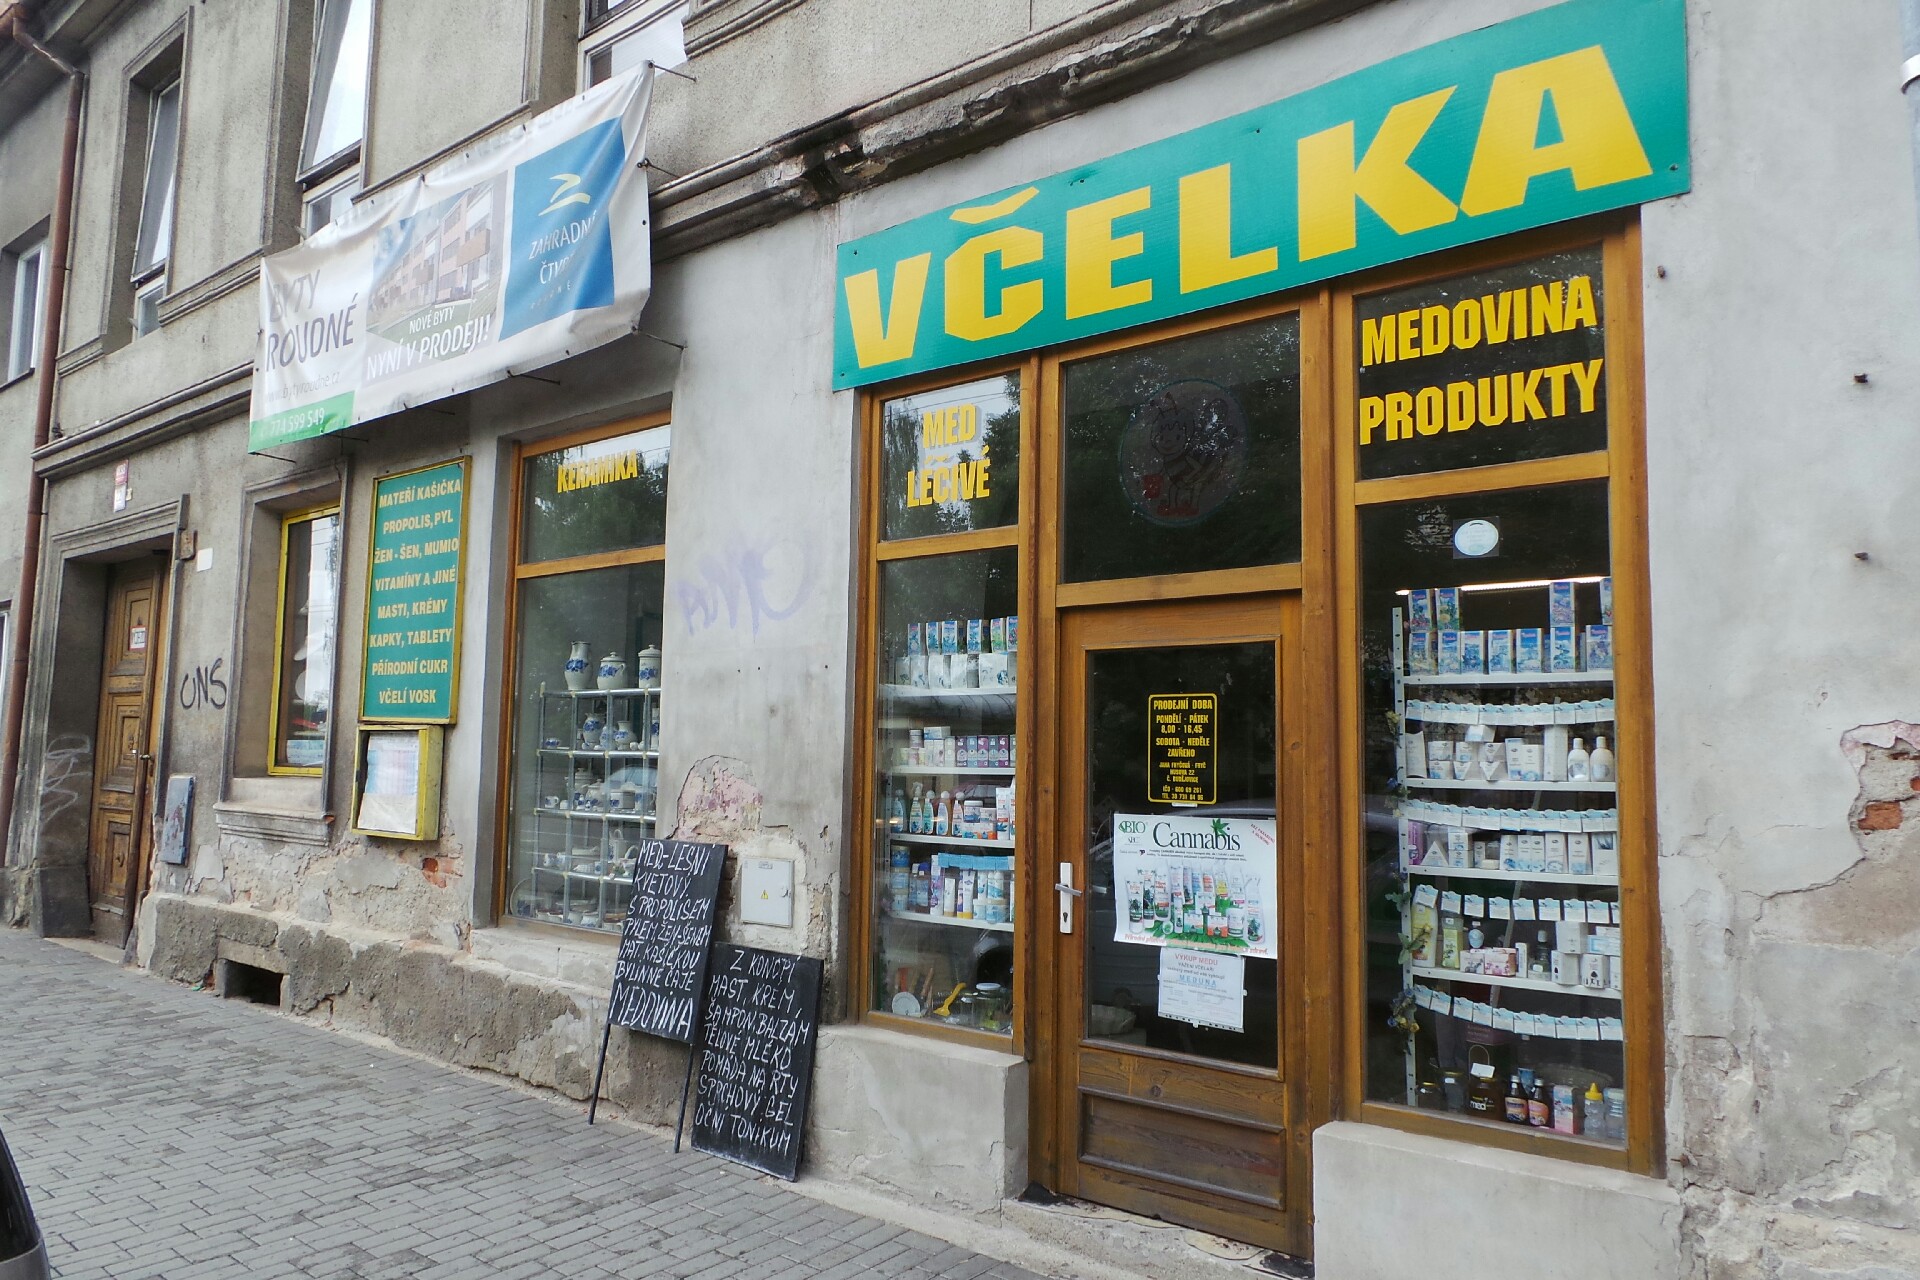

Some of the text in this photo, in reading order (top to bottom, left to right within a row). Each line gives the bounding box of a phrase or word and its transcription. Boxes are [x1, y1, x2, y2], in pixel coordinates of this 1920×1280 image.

[844, 45, 1653, 369] VČELKA
[269, 269, 321, 322] BYTY
[266, 292, 359, 372] ROUDNÉ
[409, 306, 455, 334] NOVÉ BYTY
[1362, 276, 1597, 367] MEDOVINA
[366, 314, 491, 380] NYNÍ V PRODEJI!
[1359, 358, 1604, 445] PRODUKTY
[288, 413, 304, 432] 599
[307, 408, 325, 428] 549
[922, 404, 976, 448] MED
[558, 448, 638, 493] KERAMIKA
[907, 445, 991, 508] LÉČIVÉ
[379, 479, 461, 508] MATEŘÍ KAŠIČKA
[383, 510, 453, 534] PROPOLIS, PYL
[374, 548, 393, 563] ŽEN
[400, 543, 422, 560] ŠEN,
[424, 538, 459, 555] MUMIO
[375, 565, 456, 591] VITAMÍNY A JINÉ
[377, 598, 447, 619] MASTI, KRÉMY
[370, 628, 452, 648] KAPKY, TABLETY
[372, 658, 447, 675] PŘÍRODNÍ CUKR
[379, 687, 436, 704] VČELÍ VOSK
[1153, 698, 1213, 710] PRODEJNÍ DOBA
[1156, 713, 1181, 723] PONDĚLÍ
[1189, 713, 1208, 723] PÁTEK
[1156, 738, 1180, 746] SOBOTA
[1187, 736, 1210, 746] NEDĚLE
[1167, 747, 1195, 757] ZAVŘENO
[1124, 820, 1146, 833] BIO
[1153, 821, 1240, 850] Cannabis
[639, 896, 711, 921] PROPOLISEM
[730, 950, 744, 971] Z
[608, 982, 694, 1040] MEDOVINA
[743, 1036, 791, 1070] MLÉKO
[701, 1050, 798, 1098] POMÁDA NA RTY
[765, 1095, 793, 1126] GEL
